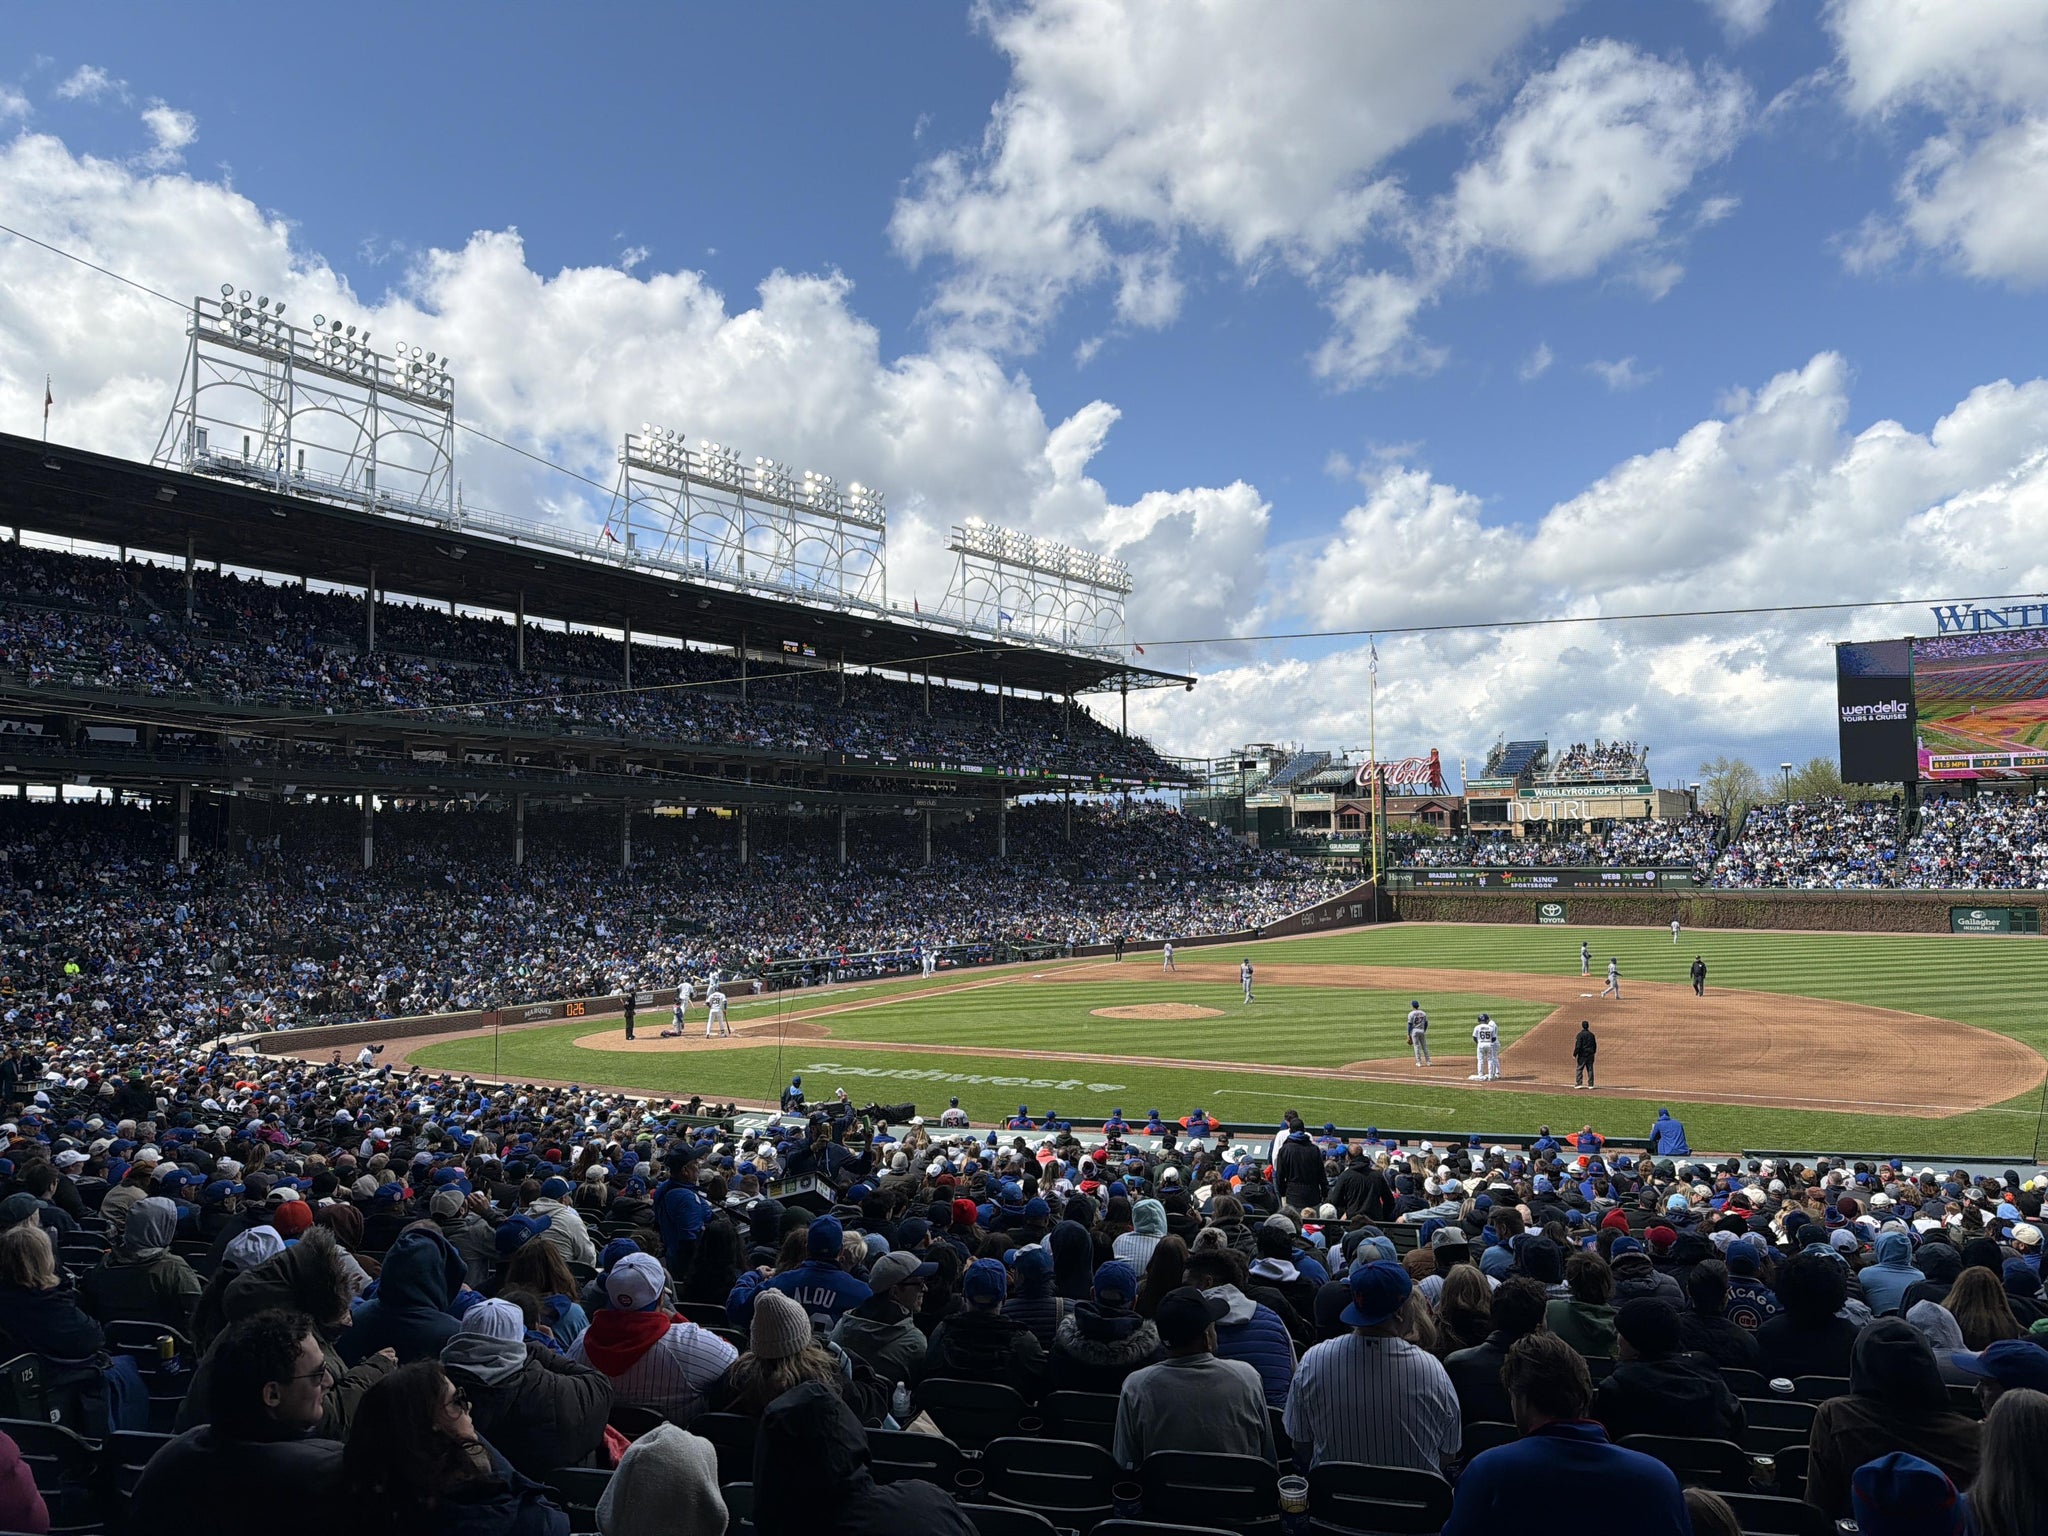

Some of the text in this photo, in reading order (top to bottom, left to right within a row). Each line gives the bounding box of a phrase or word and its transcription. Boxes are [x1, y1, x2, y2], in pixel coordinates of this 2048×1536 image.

[1841, 700, 1907, 715] wendella
[1952, 760, 1967, 768] MPH
[1388, 873, 1413, 882] Harvey
[1502, 876, 1558, 884] DRAFTKINGS
[1349, 904, 1363, 919] YETI
[1957, 917, 2000, 926] Gallagher
[524, 1007, 552, 1018] MARQUEE
[792, 1063, 1084, 1091] Southwest
[946, 1117, 960, 1127] 63
[793, 1286, 837, 1309] ALOU
[21, 1367, 34, 1382] 125
